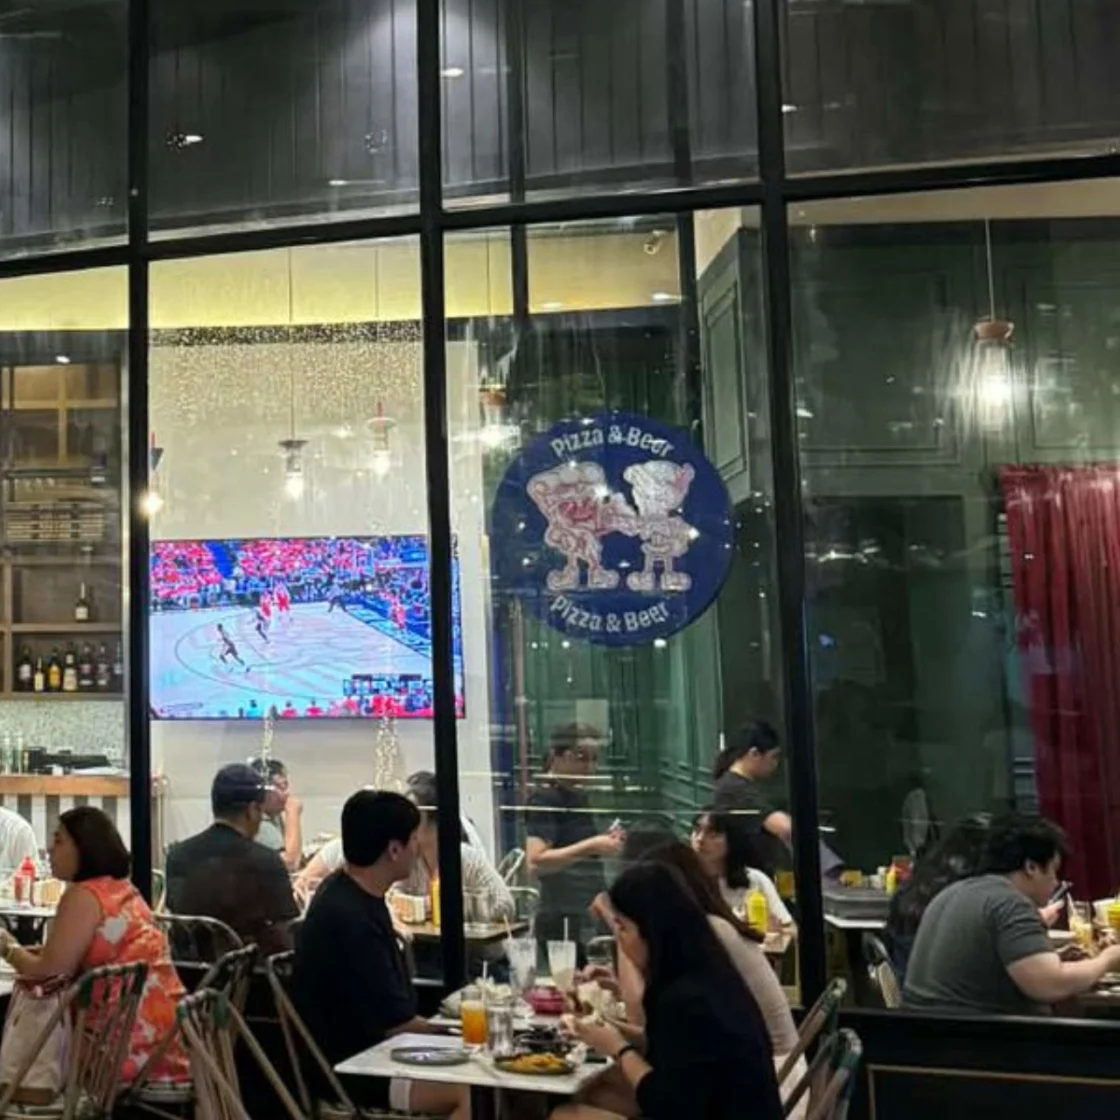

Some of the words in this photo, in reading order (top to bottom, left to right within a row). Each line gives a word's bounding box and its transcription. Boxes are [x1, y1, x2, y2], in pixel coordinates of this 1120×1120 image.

[550, 428, 604, 457] Pizza
[608, 425, 623, 445] &
[627, 426, 675, 457] Beer
[550, 595, 602, 631] Pizza
[605, 614, 621, 633] &
[624, 600, 670, 631] Beer
